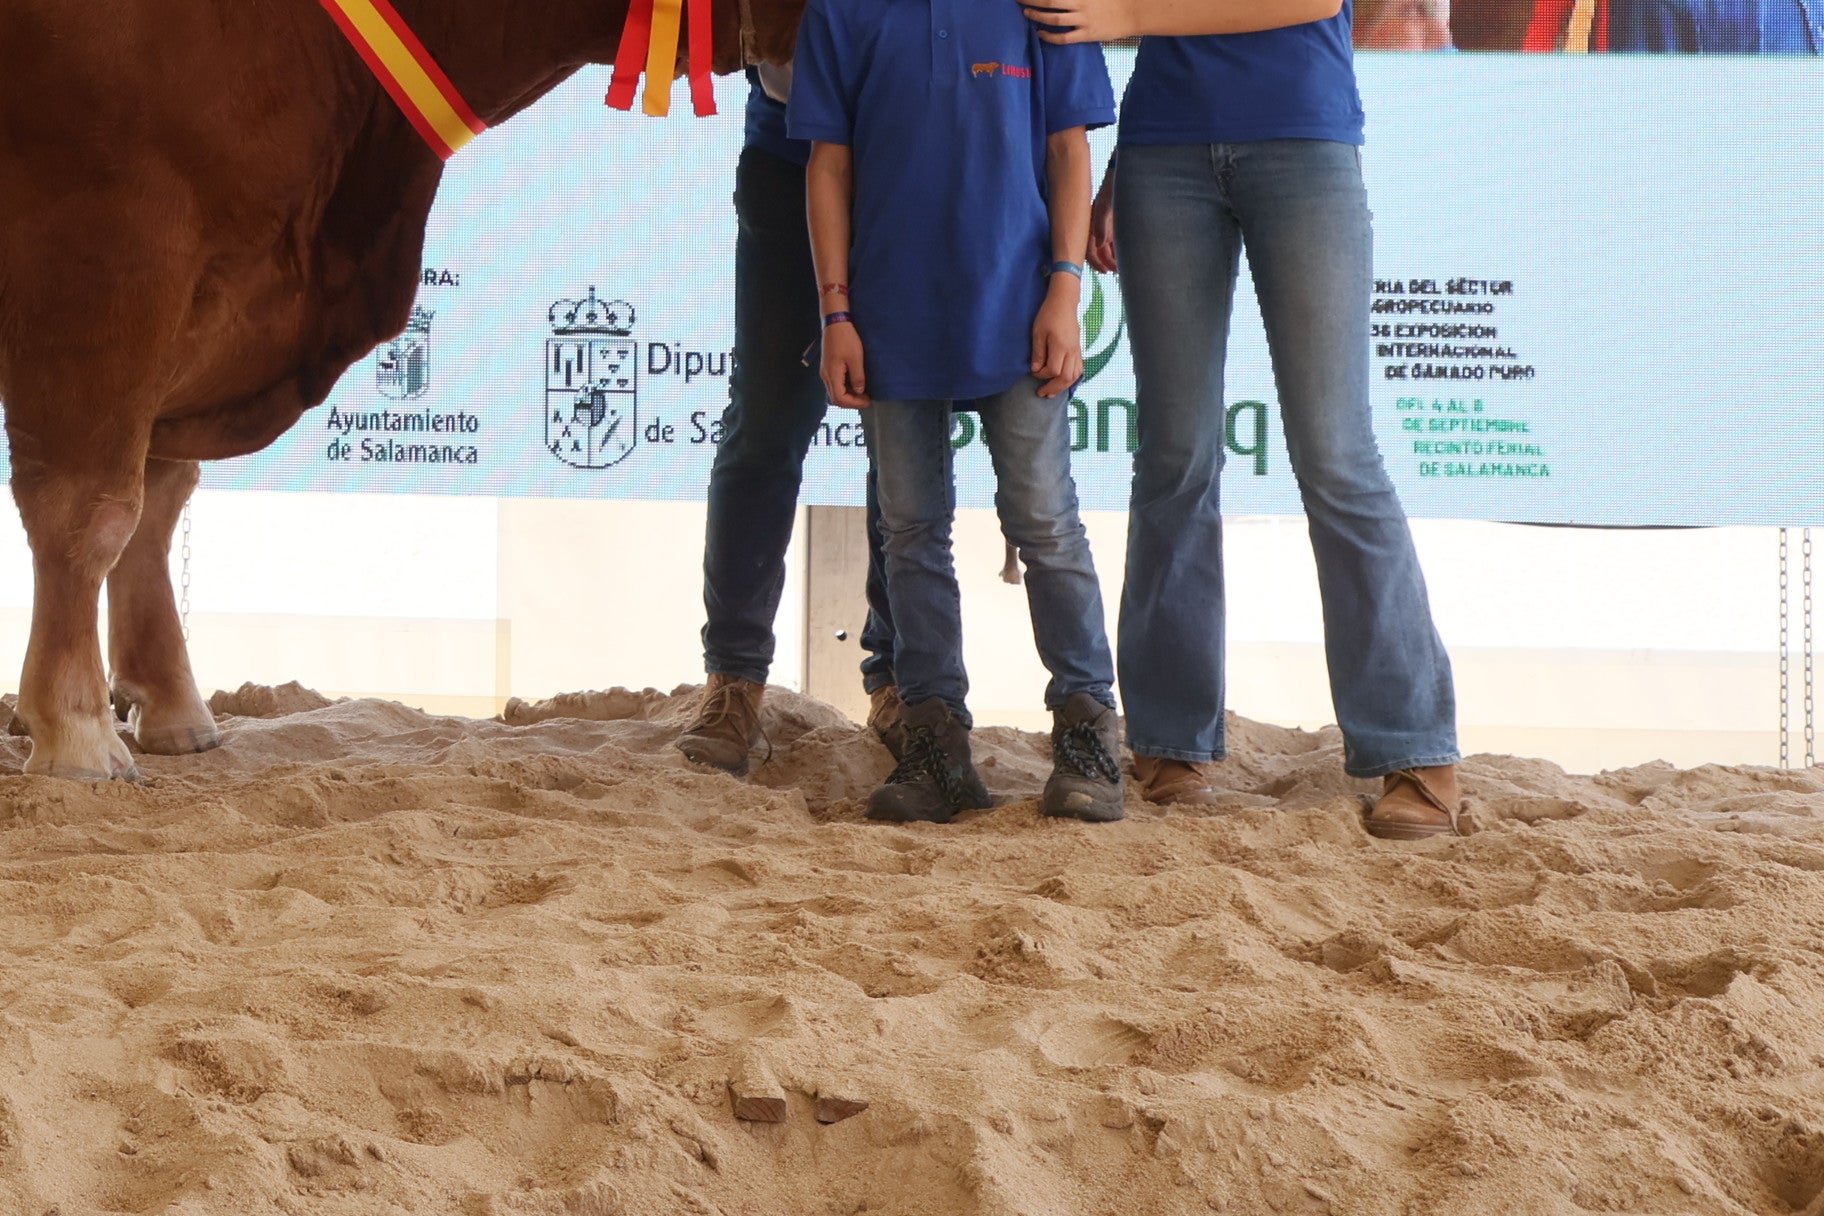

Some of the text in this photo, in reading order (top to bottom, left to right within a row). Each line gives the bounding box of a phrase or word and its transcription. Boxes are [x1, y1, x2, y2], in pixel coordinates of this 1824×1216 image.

[1409, 278, 1441, 295] DEL
[1385, 364, 1407, 380] DE
[1447, 398, 1467, 413] AL
[327, 406, 479, 435] Ayuntamiento
[1402, 418, 1424, 432] DE
[645, 417, 674, 444] de
[327, 438, 479, 464] de Salamanca
[1419, 461, 1440, 477] DE
